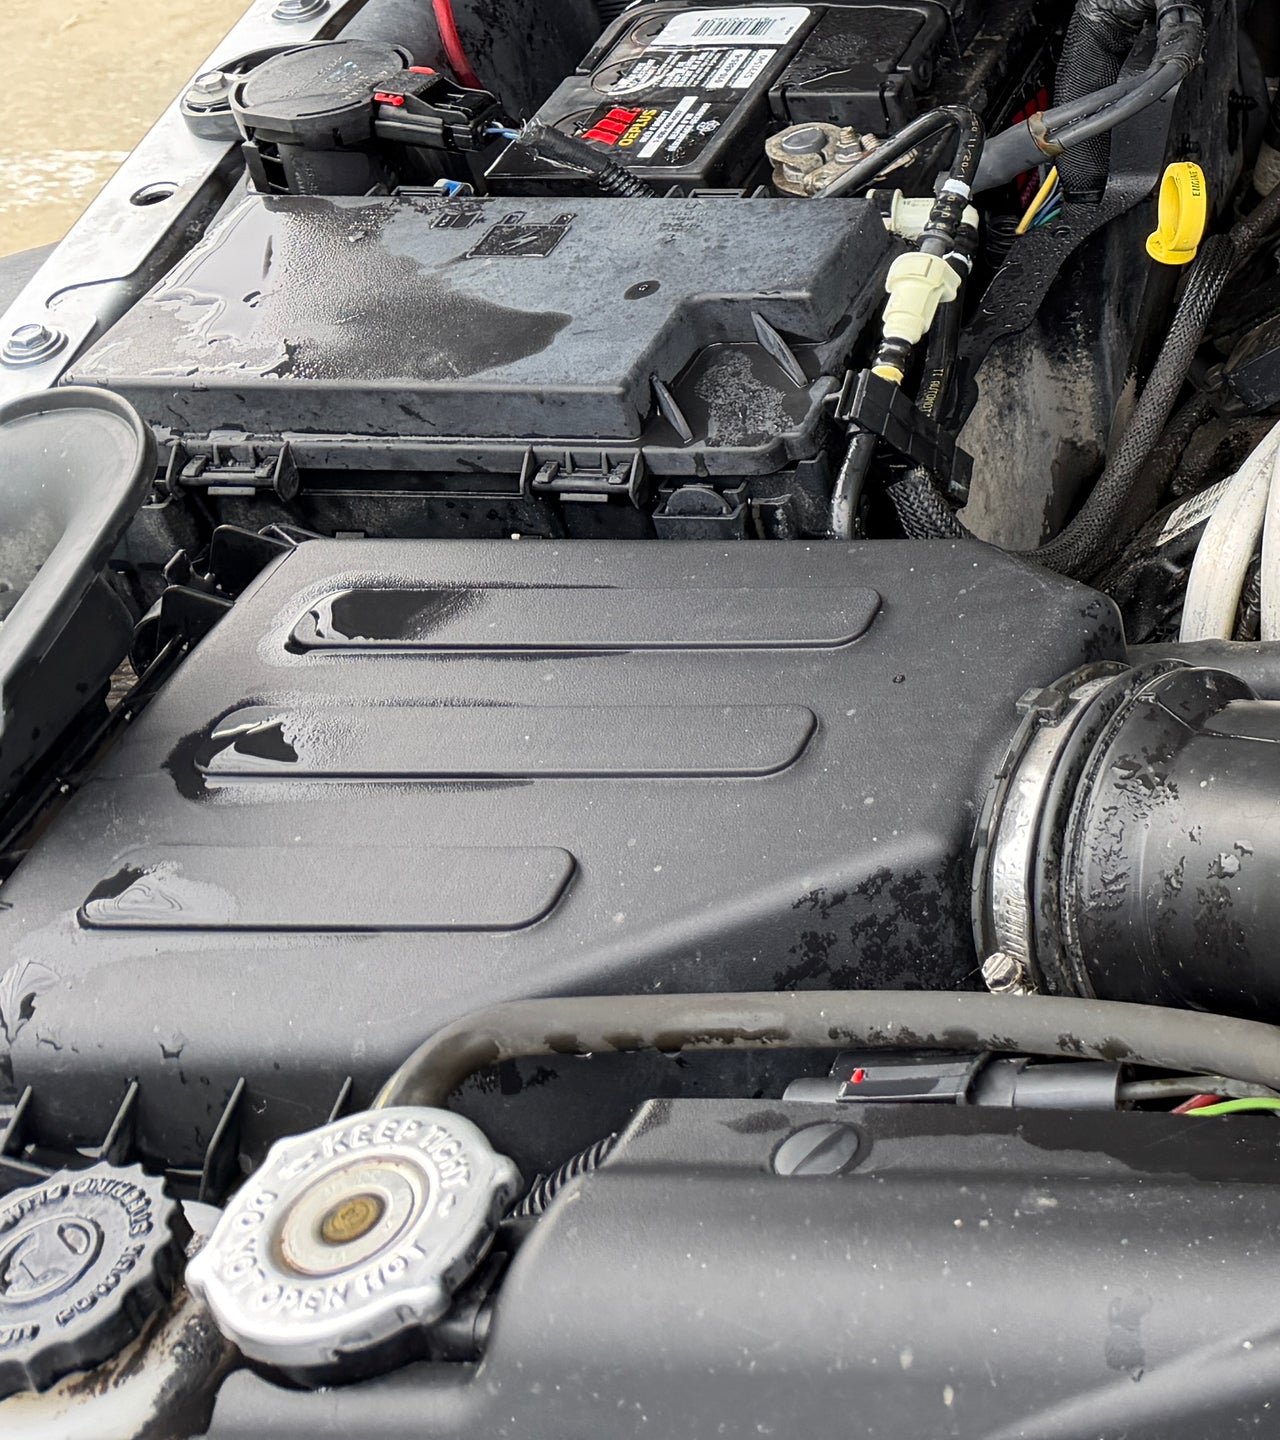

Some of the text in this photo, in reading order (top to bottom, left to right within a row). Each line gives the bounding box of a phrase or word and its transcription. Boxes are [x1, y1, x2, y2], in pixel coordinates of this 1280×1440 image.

[321, 1119, 471, 1189] KEEP TIGHT
[72, 1177, 153, 1238] STEERING
[254, 1283, 348, 1315] OPEN
[354, 1242, 427, 1297] HOT
